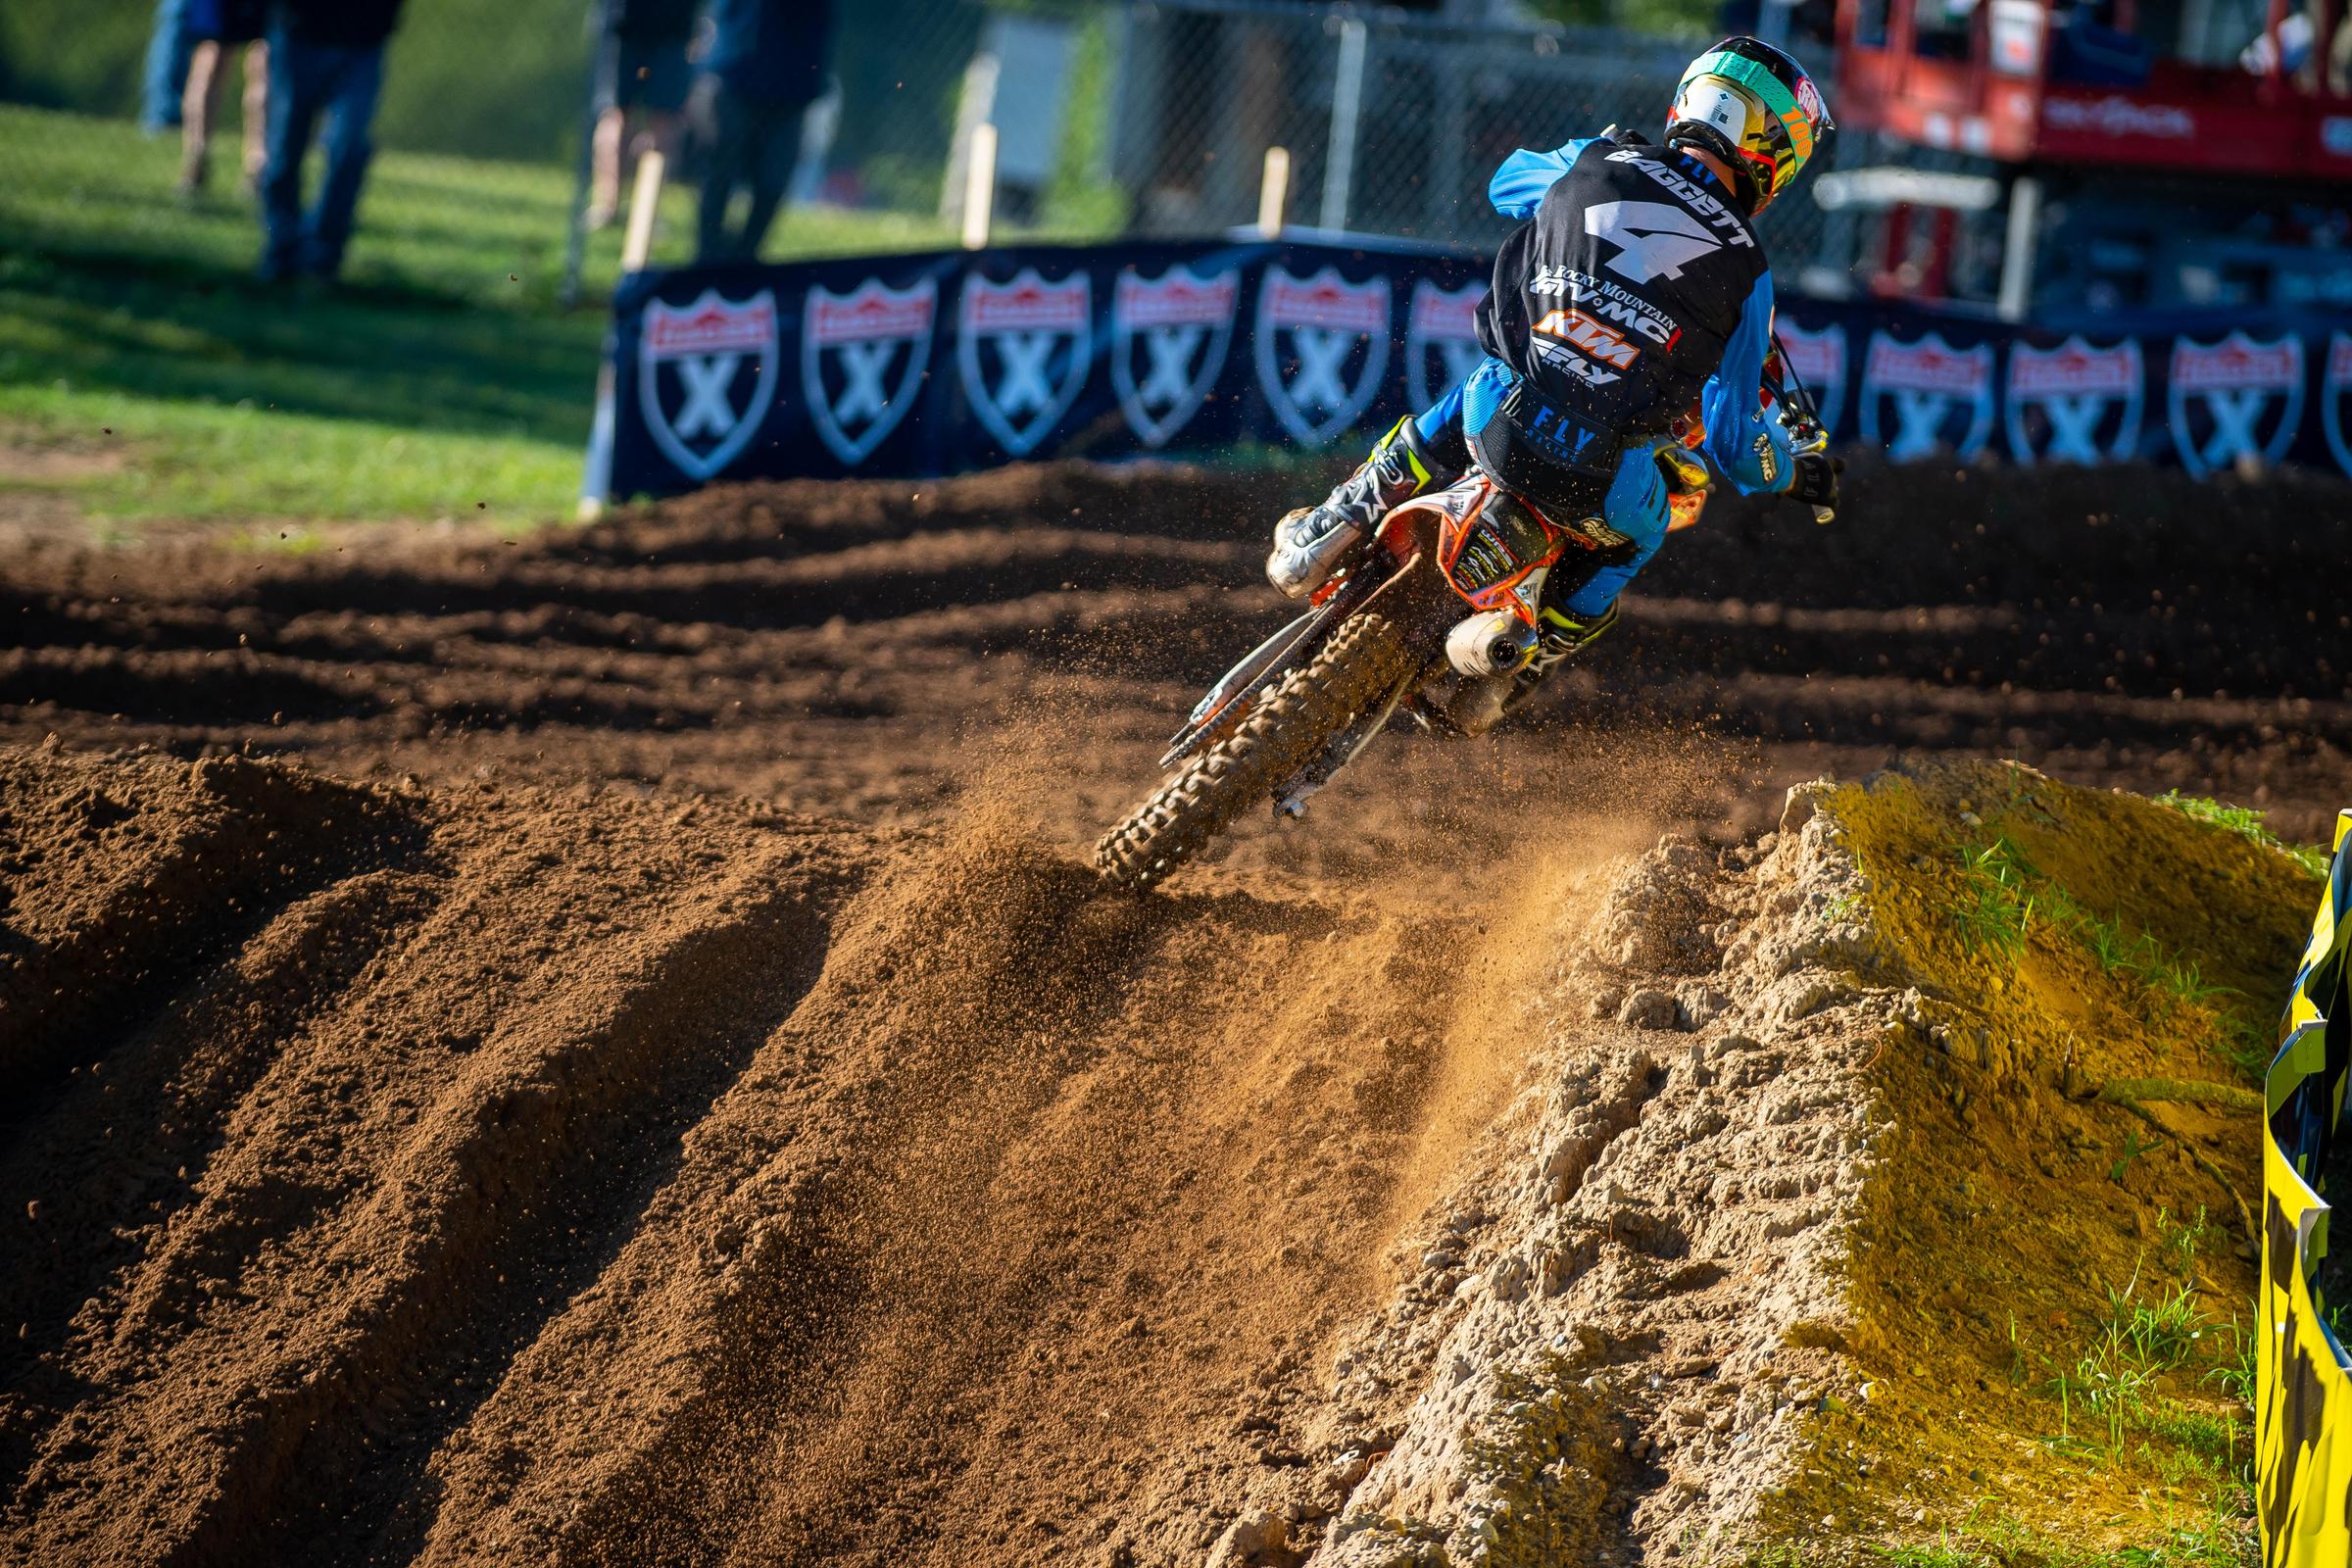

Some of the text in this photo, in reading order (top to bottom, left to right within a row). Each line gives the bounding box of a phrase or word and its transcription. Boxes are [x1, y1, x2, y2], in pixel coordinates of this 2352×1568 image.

[1604, 150, 1754, 247] BAGGETT
[1680, 156, 1717, 184] FLY
[1585, 201, 1722, 284] 4
[1554, 265, 1678, 329] ROCKY MOUNTAIN
[995, 333, 1055, 414] X
[1141, 327, 1200, 408] X
[1290, 329, 1350, 410] X
[1531, 337, 1622, 384] FLY
[1533, 309, 1640, 369] KTM
[1542, 358, 1595, 390] RACING
[676, 354, 737, 439] X
[834, 342, 896, 423] X
[1533, 405, 1595, 451] FLY
[2045, 392, 2103, 466] X
[2205, 388, 2268, 466] X
